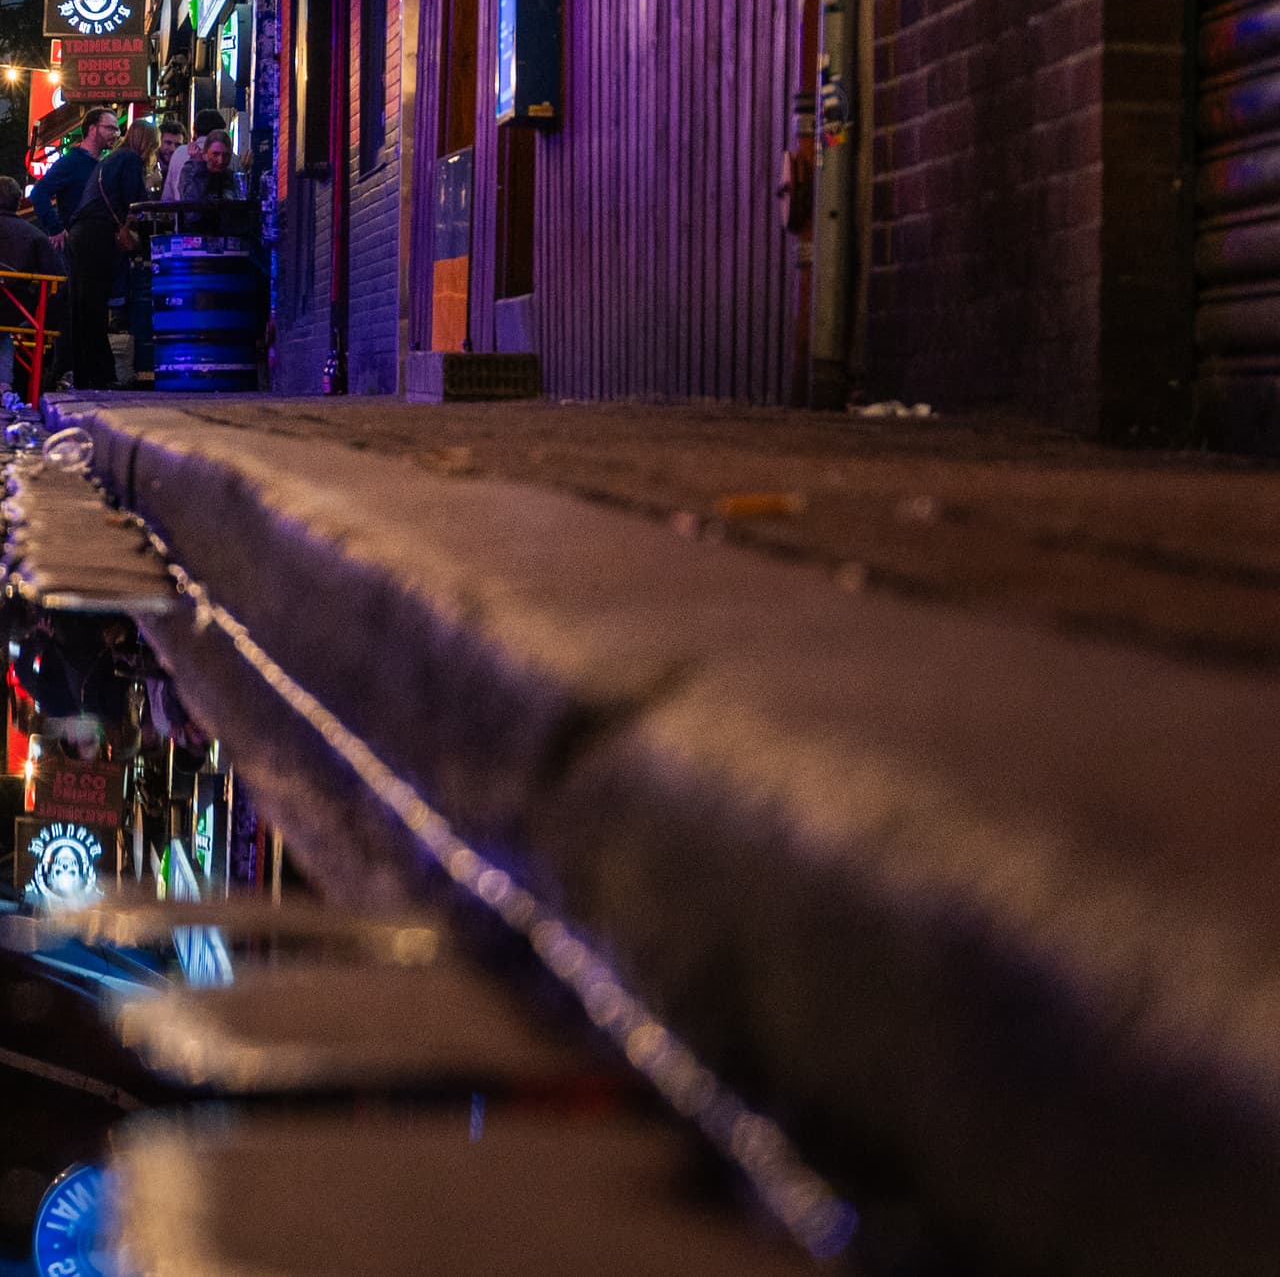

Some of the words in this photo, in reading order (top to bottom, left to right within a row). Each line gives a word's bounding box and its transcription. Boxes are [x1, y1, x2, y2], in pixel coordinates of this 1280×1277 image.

[57, 1, 131, 34] Hamburg
[65, 38, 144, 53] TRINKBAR
[78, 59, 130, 71] DRINKS
[79, 74, 100, 87] TO
[103, 74, 130, 87] GO
